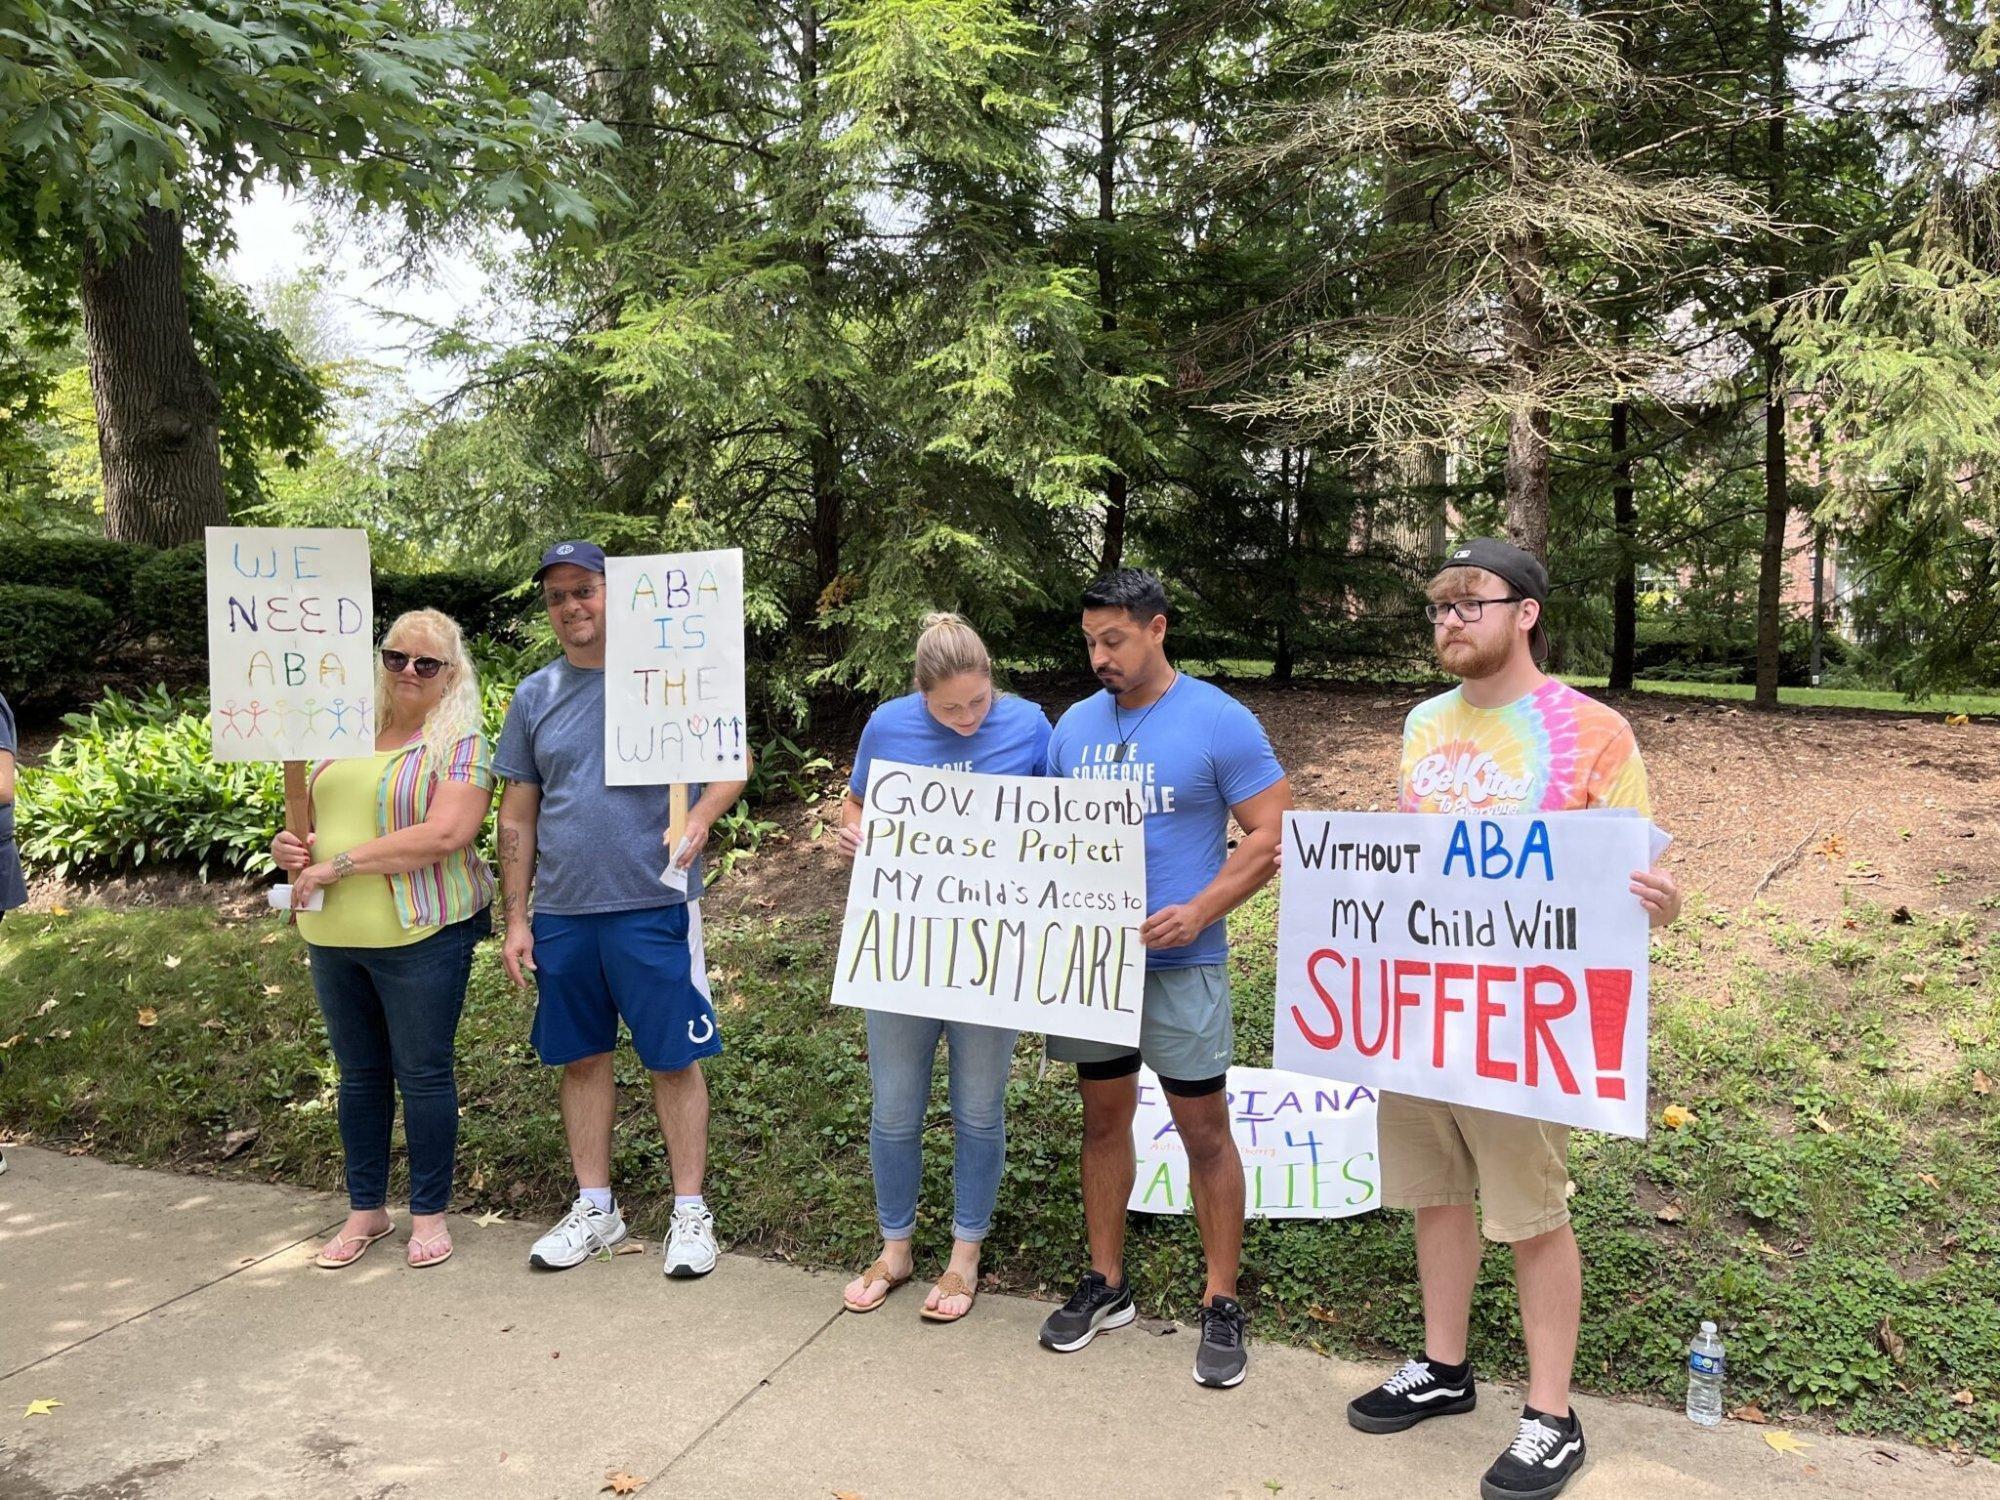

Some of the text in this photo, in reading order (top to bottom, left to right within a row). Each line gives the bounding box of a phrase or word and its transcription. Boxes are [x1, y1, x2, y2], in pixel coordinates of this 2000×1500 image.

[234, 543, 321, 579] WE
[631, 569, 720, 612] ABA
[228, 595, 363, 634] NEED
[654, 614, 706, 650] IS
[248, 650, 346, 687] ABA
[633, 666, 719, 706] THE
[932, 760, 973, 774] OVE
[1072, 762, 1156, 783] SOMEONE
[1081, 743, 1138, 764] I LOE
[994, 784, 1143, 827] Holcomb
[864, 817, 1125, 865] Please Protect
[1442, 819, 1555, 882] ABA
[936, 875, 1029, 907] Child's
[1037, 879, 1116, 911] Access
[1121, 889, 1143, 911] to
[1407, 899, 1496, 948] Child
[1504, 899, 1578, 951] Will
[848, 908, 1141, 1014] AUTISM CARE
[1290, 948, 1634, 1102] SUFFER!
[1137, 1085, 1376, 1115] IIANA
[1153, 1117, 1324, 1164] AT 4
[1137, 1152, 1375, 1209] ALIES
